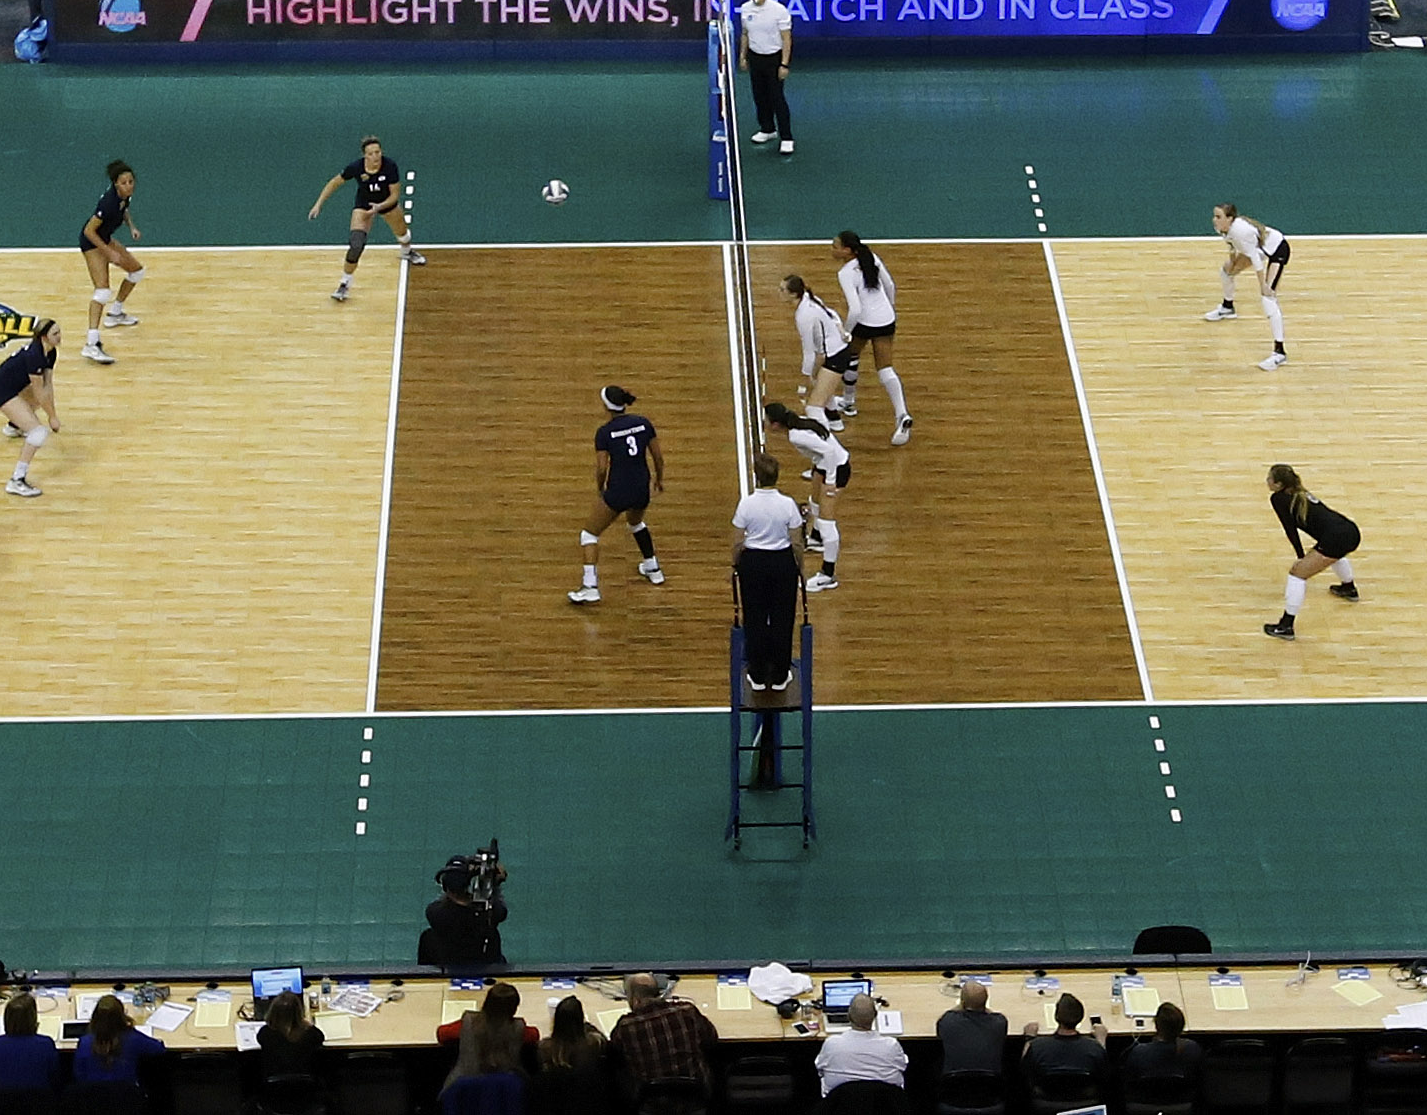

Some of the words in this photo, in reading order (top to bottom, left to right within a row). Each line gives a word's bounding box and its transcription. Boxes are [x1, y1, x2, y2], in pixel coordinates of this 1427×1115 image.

[1275, 2, 1326, 18] NCAA
[98, 11, 147, 26] NCAA
[626, 435, 638, 456] 3
